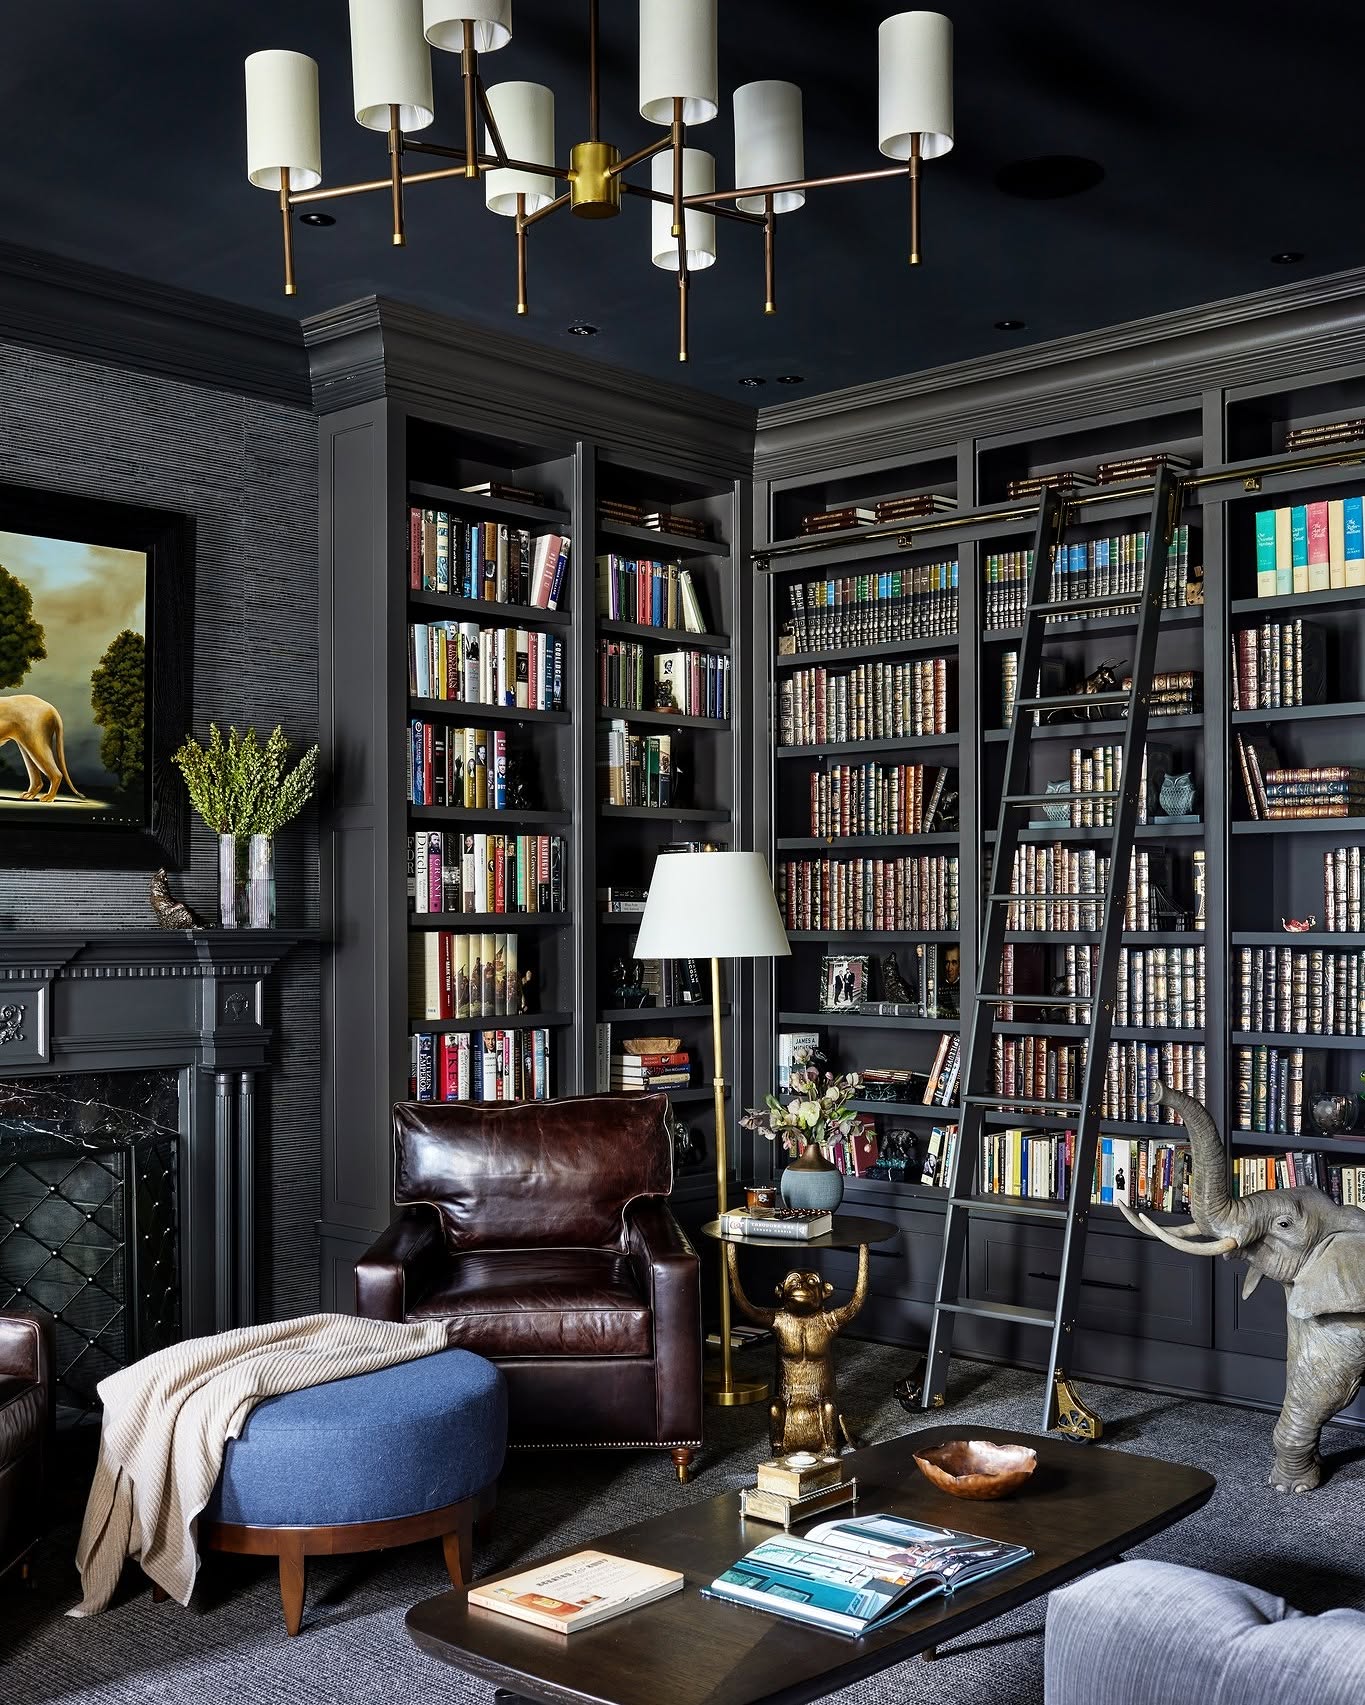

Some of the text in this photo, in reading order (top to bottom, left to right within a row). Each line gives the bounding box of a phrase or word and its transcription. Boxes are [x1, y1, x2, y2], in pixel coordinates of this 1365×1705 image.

[417, 835, 426, 874] Dutch
[448, 1049, 457, 1081] IKE
[944, 1038, 960, 1072] SPILLOVER
